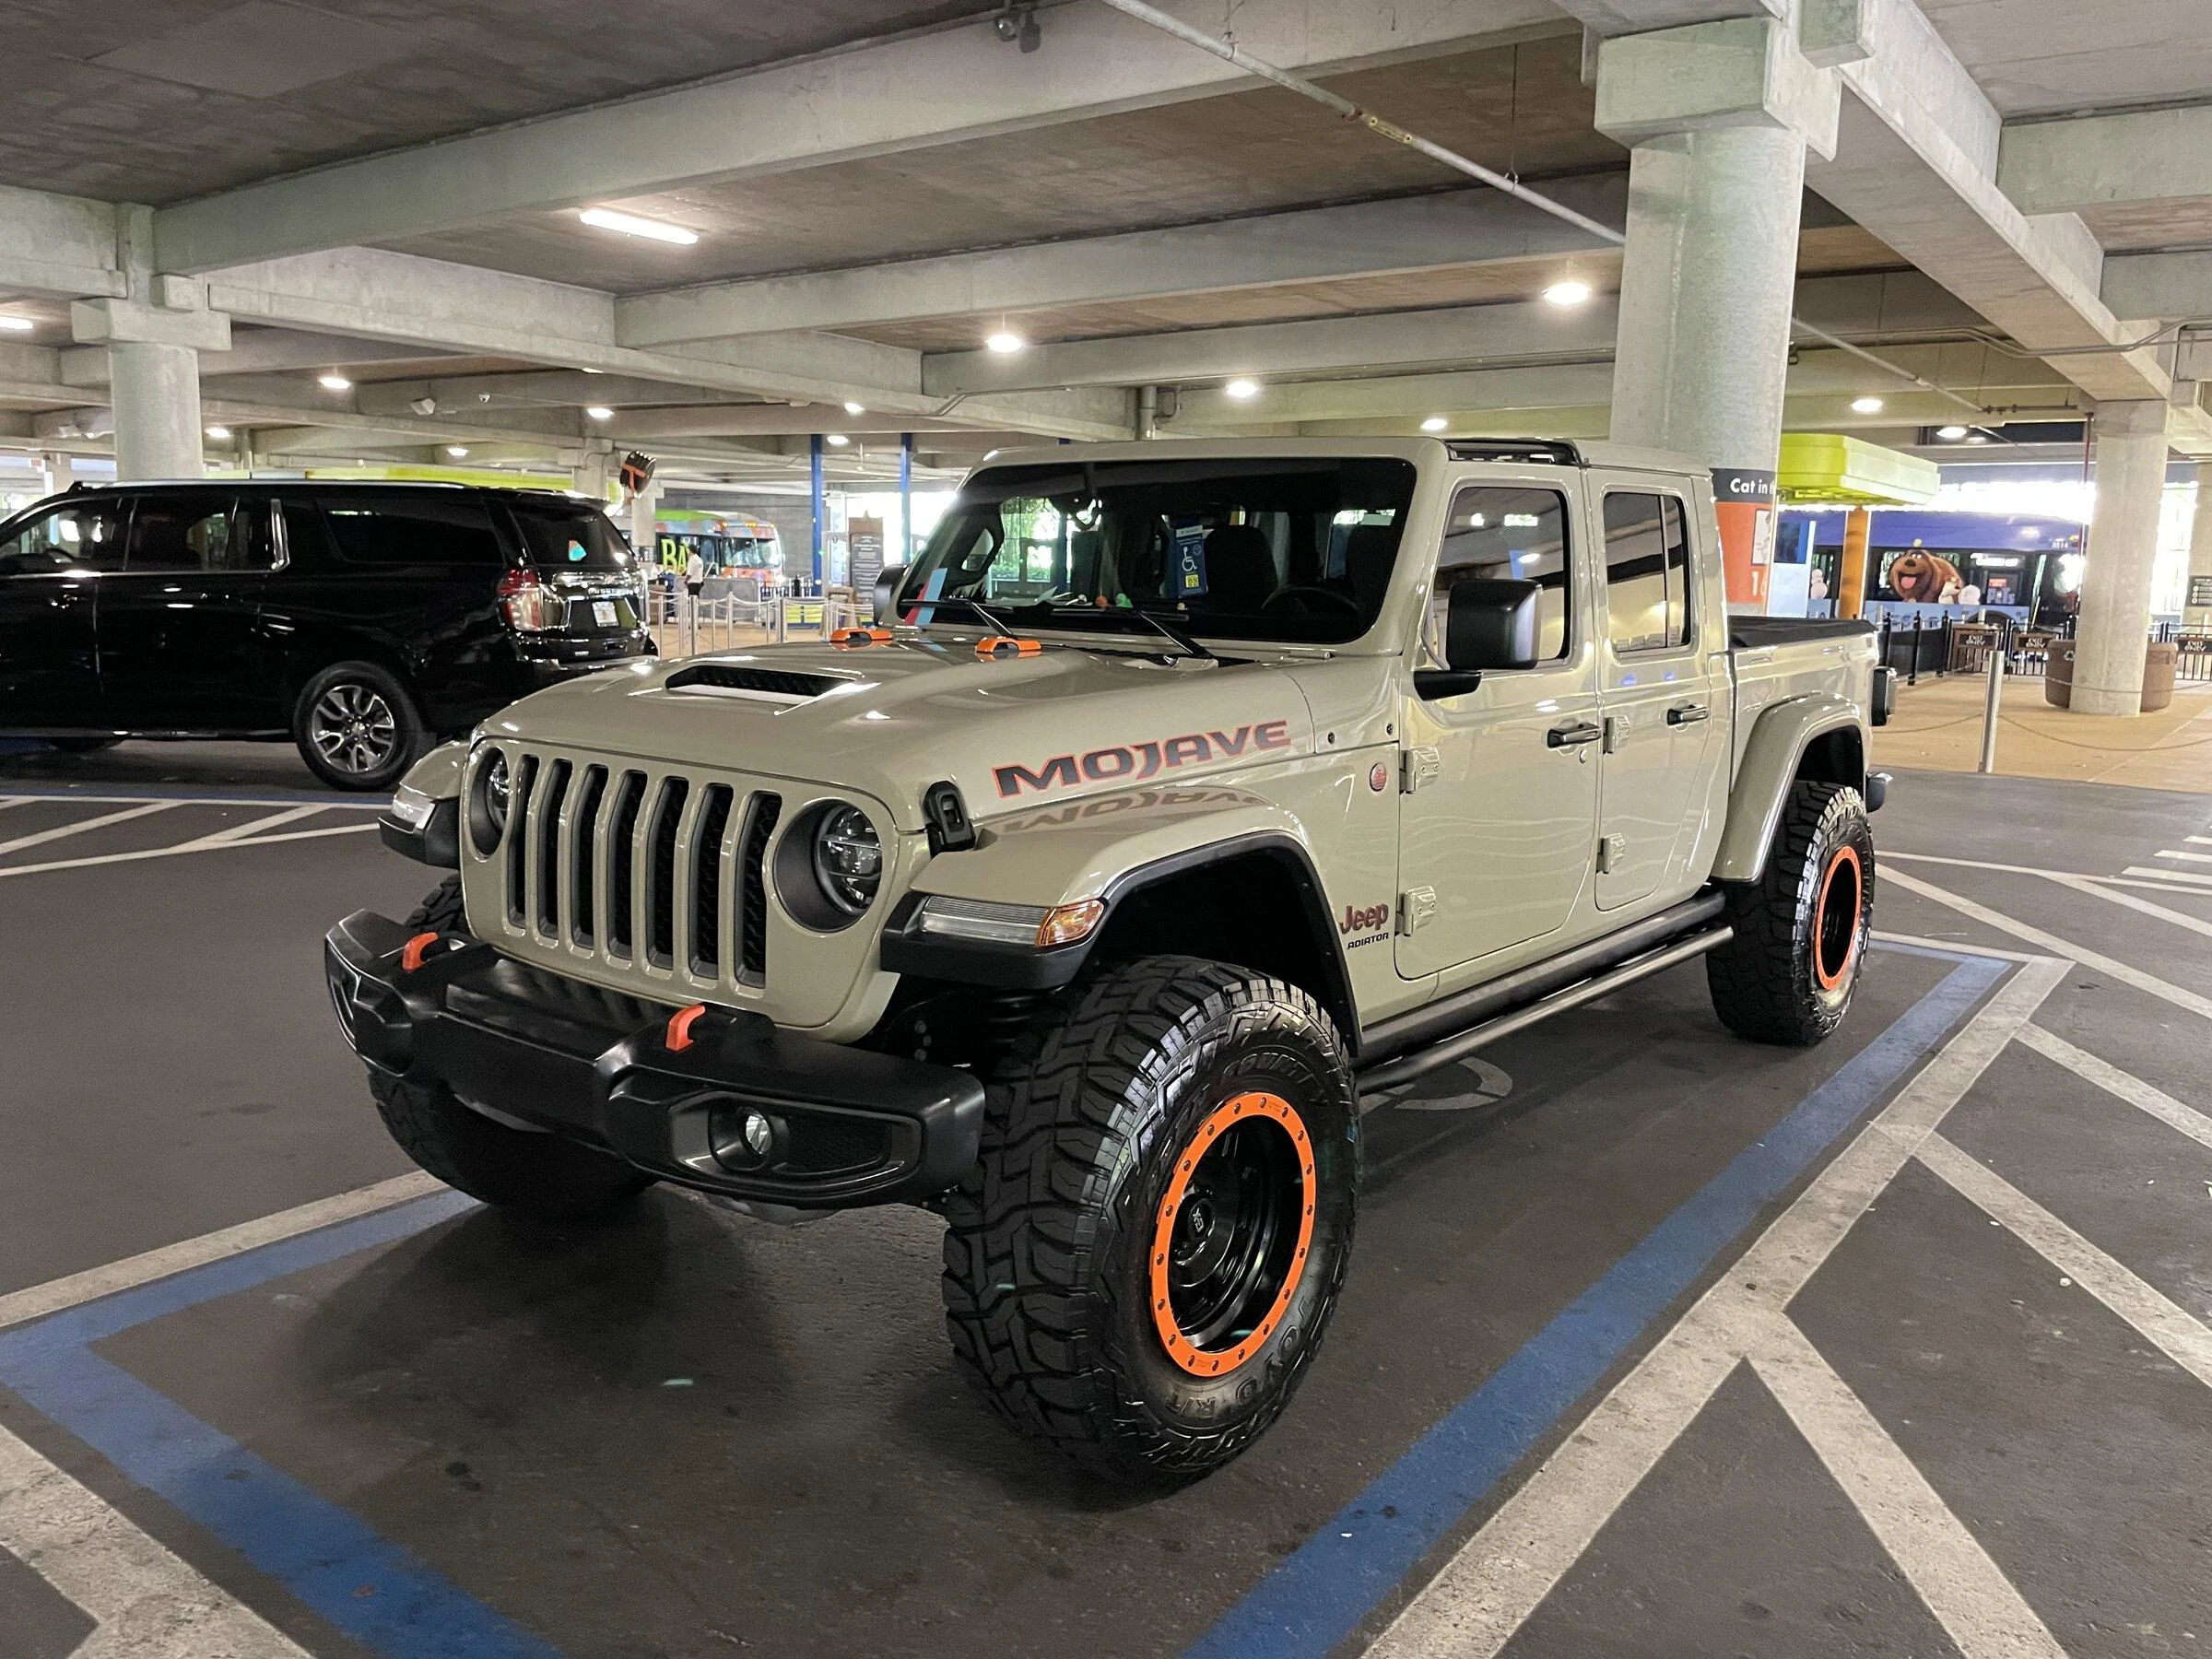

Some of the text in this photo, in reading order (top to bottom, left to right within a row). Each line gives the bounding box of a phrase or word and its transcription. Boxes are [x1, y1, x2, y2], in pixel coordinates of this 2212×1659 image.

[1730, 477, 1756, 494] Cat
[1758, 478, 1768, 495] in
[661, 537, 688, 575] BA
[992, 720, 1291, 799] MOJAVE
[1339, 903, 1389, 935] Jeep
